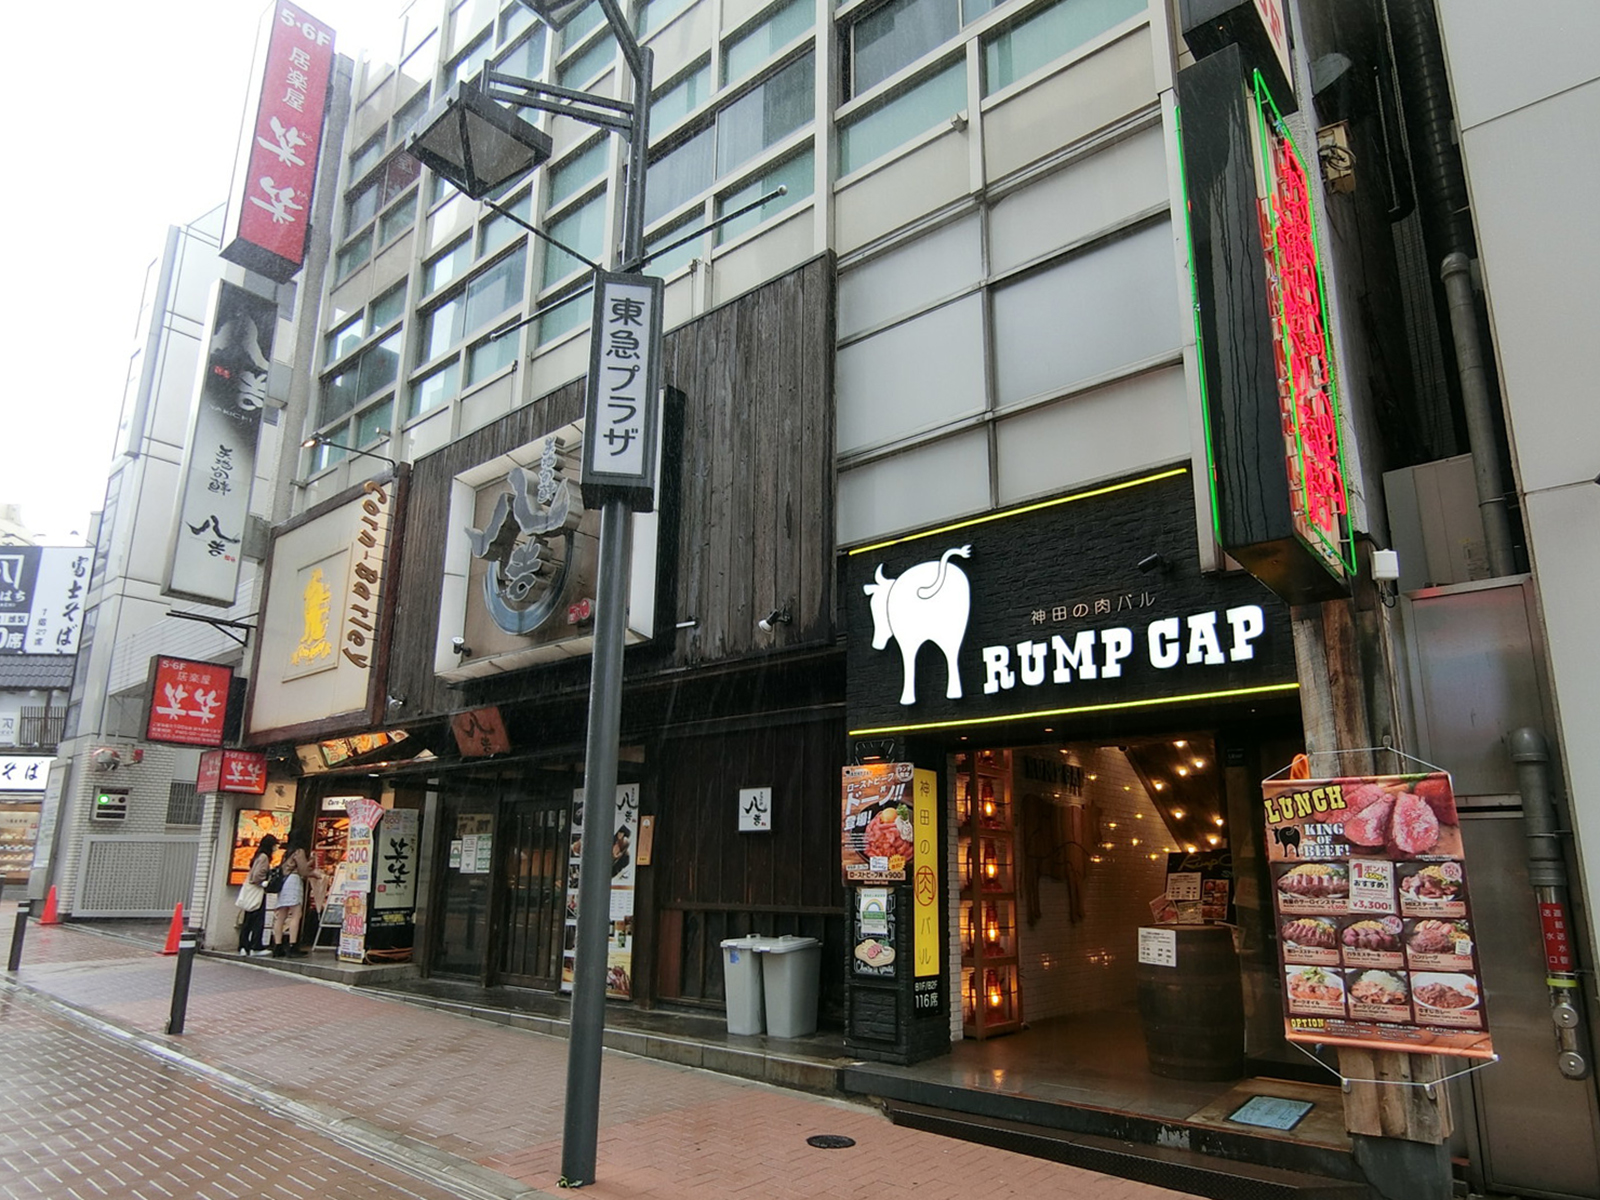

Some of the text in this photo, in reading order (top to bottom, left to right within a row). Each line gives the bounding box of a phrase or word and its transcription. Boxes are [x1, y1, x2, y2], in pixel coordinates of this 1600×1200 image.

[282, 46, 311, 113] 居楽屋
[603, 297, 645, 457] 東急プラザ
[342, 480, 388, 669] Corn-Barley
[56, 555, 89, 646] 富士そば
[1030, 590, 1156, 626] 神田の肉バル
[982, 604, 1264, 695] RUMP CAP
[2, 760, 44, 781] そば
[847, 772, 895, 793] ローストビーフ
[1263, 785, 1347, 824] LUNCH
[1304, 823, 1344, 836] KING
[1316, 835, 1332, 845] OF
[1303, 844, 1351, 857] BEEF!
[915, 780, 937, 965] 神田の肉バル
[1352, 899, 1389, 911] ¥3,300
[914, 980, 938, 992] B1F/B2F
[914, 992, 939, 1009] 116席
[1291, 1018, 1325, 1029] OPTION
